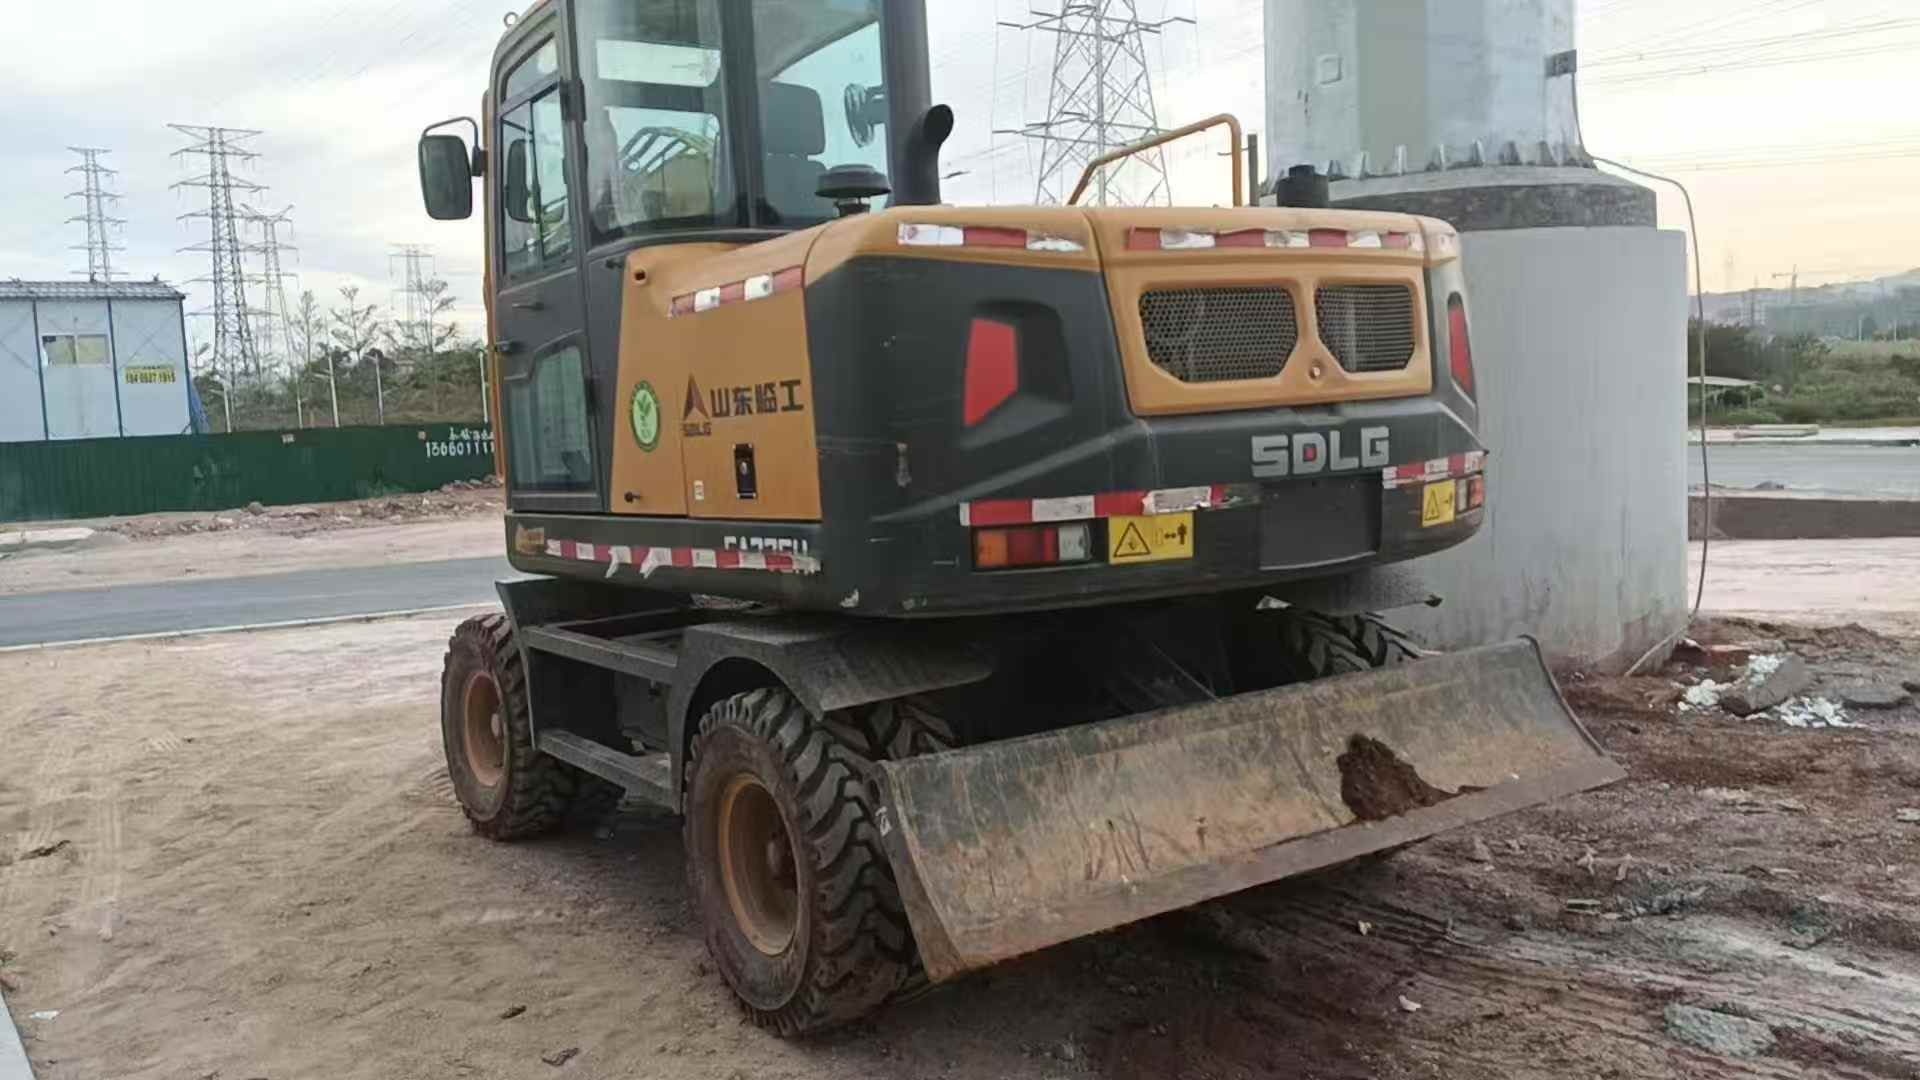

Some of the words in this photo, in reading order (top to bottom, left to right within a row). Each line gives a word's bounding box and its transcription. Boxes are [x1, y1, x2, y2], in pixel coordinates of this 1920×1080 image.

[710, 379, 804, 417] 山东临工
[682, 422, 712, 437] SDLG
[1251, 426, 1390, 478] SDLG
